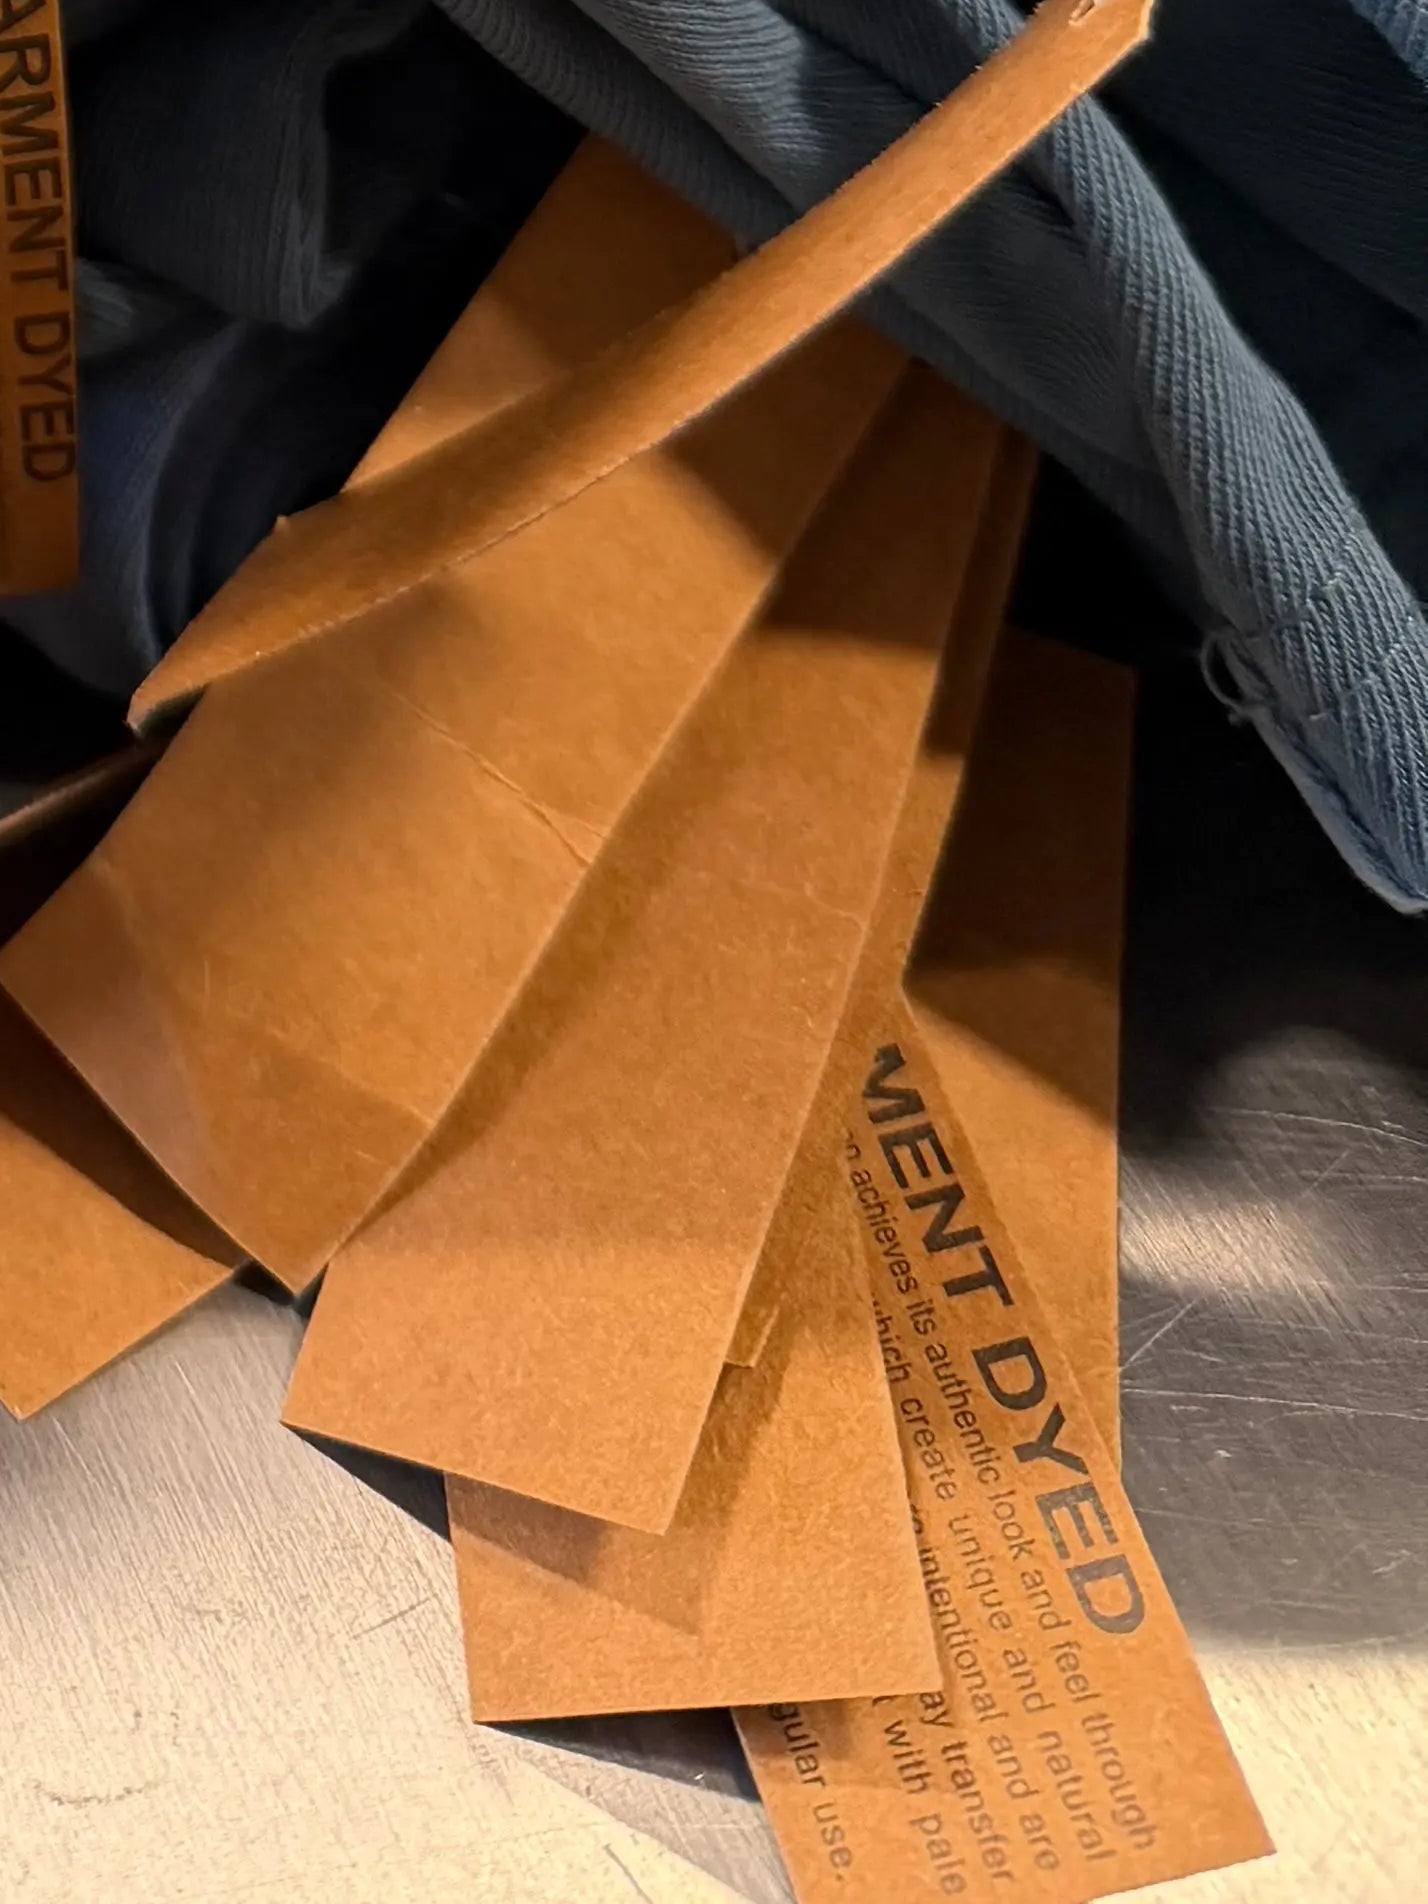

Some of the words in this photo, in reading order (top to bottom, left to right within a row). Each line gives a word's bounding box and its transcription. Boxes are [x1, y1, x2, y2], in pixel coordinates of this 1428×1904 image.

[12, 311, 76, 483] DYED
[859, 1041, 1015, 1308] MENT
[969, 1335, 1145, 1634] DYED
[848, 1167, 920, 1296] achieves
[904, 1296, 938, 1337] its
[922, 1340, 1002, 1486] authentic
[985, 1488, 1036, 1562] look
[1018, 1568, 1072, 1631] and
[1048, 1639, 1102, 1704] feel
[1079, 1711, 1157, 1849] through
[897, 1396, 958, 1501] create
[946, 1512, 1013, 1631] unique
[1000, 1647, 1057, 1714] and
[1035, 1729, 1116, 1861] natural
[767, 1700, 827, 1788] gular
[811, 1801, 853, 1882] use.
[881, 1718, 934, 1795] with
[916, 1682, 957, 1729] ay
[938, 1739, 1014, 1880] transfer
[985, 1733, 1041, 1800] and
[1018, 1812, 1060, 1870] are
[906, 1812, 966, 1893] pale
